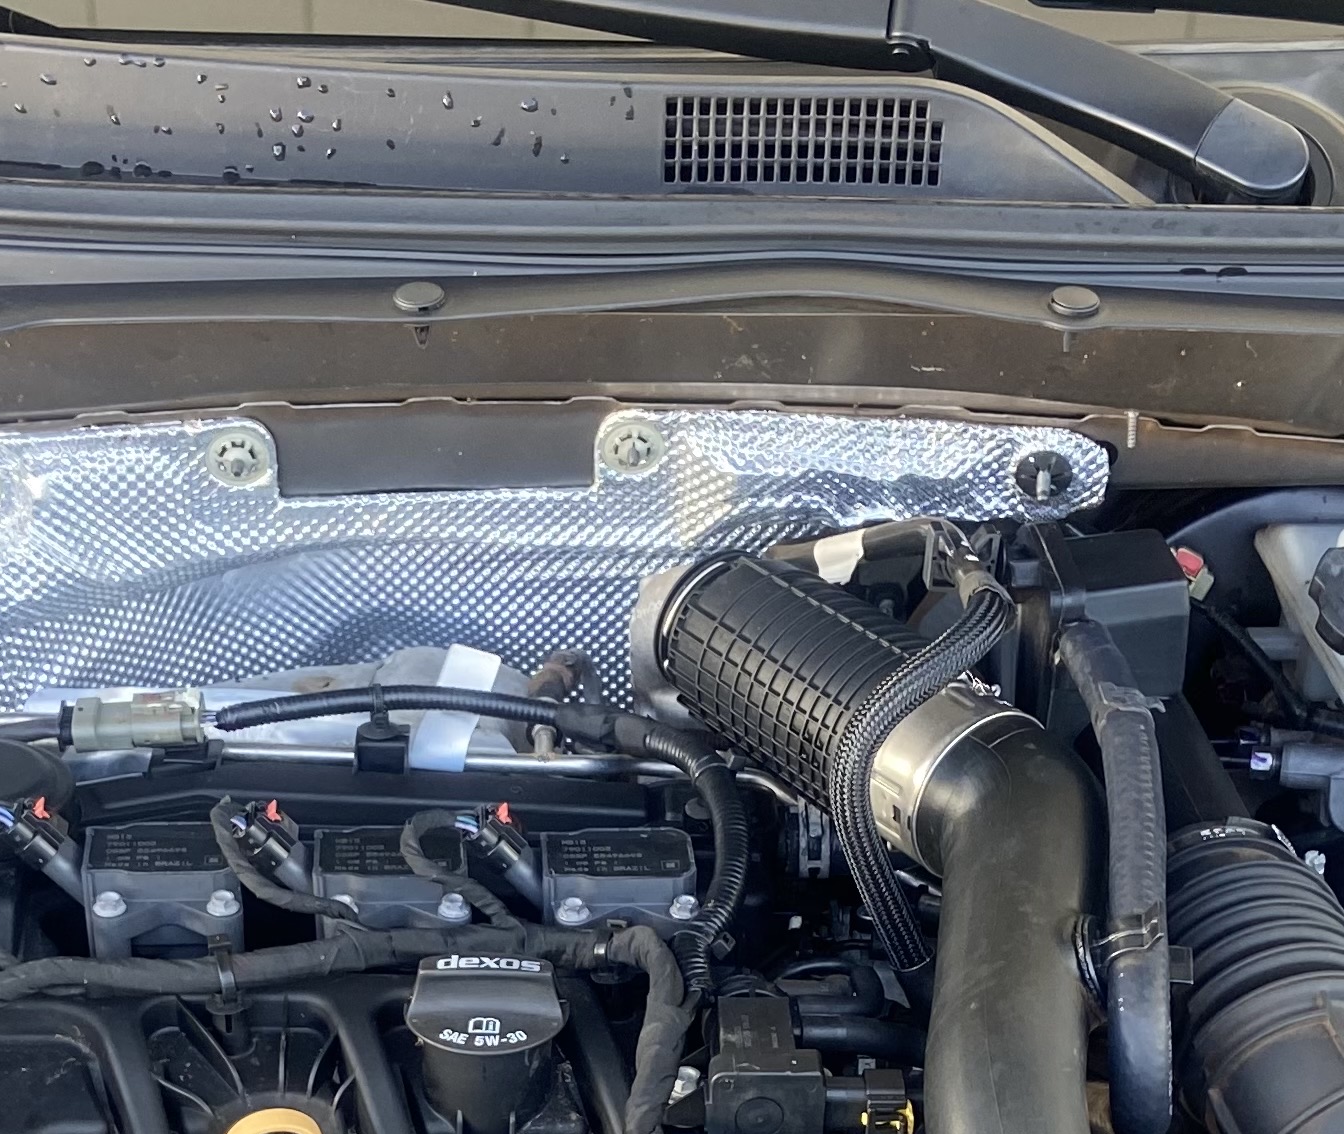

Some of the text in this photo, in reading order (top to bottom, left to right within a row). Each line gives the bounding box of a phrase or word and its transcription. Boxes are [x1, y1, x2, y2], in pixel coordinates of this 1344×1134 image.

[436, 955, 541, 972] dexos
[439, 1028, 528, 1047] SAE 5W-30
